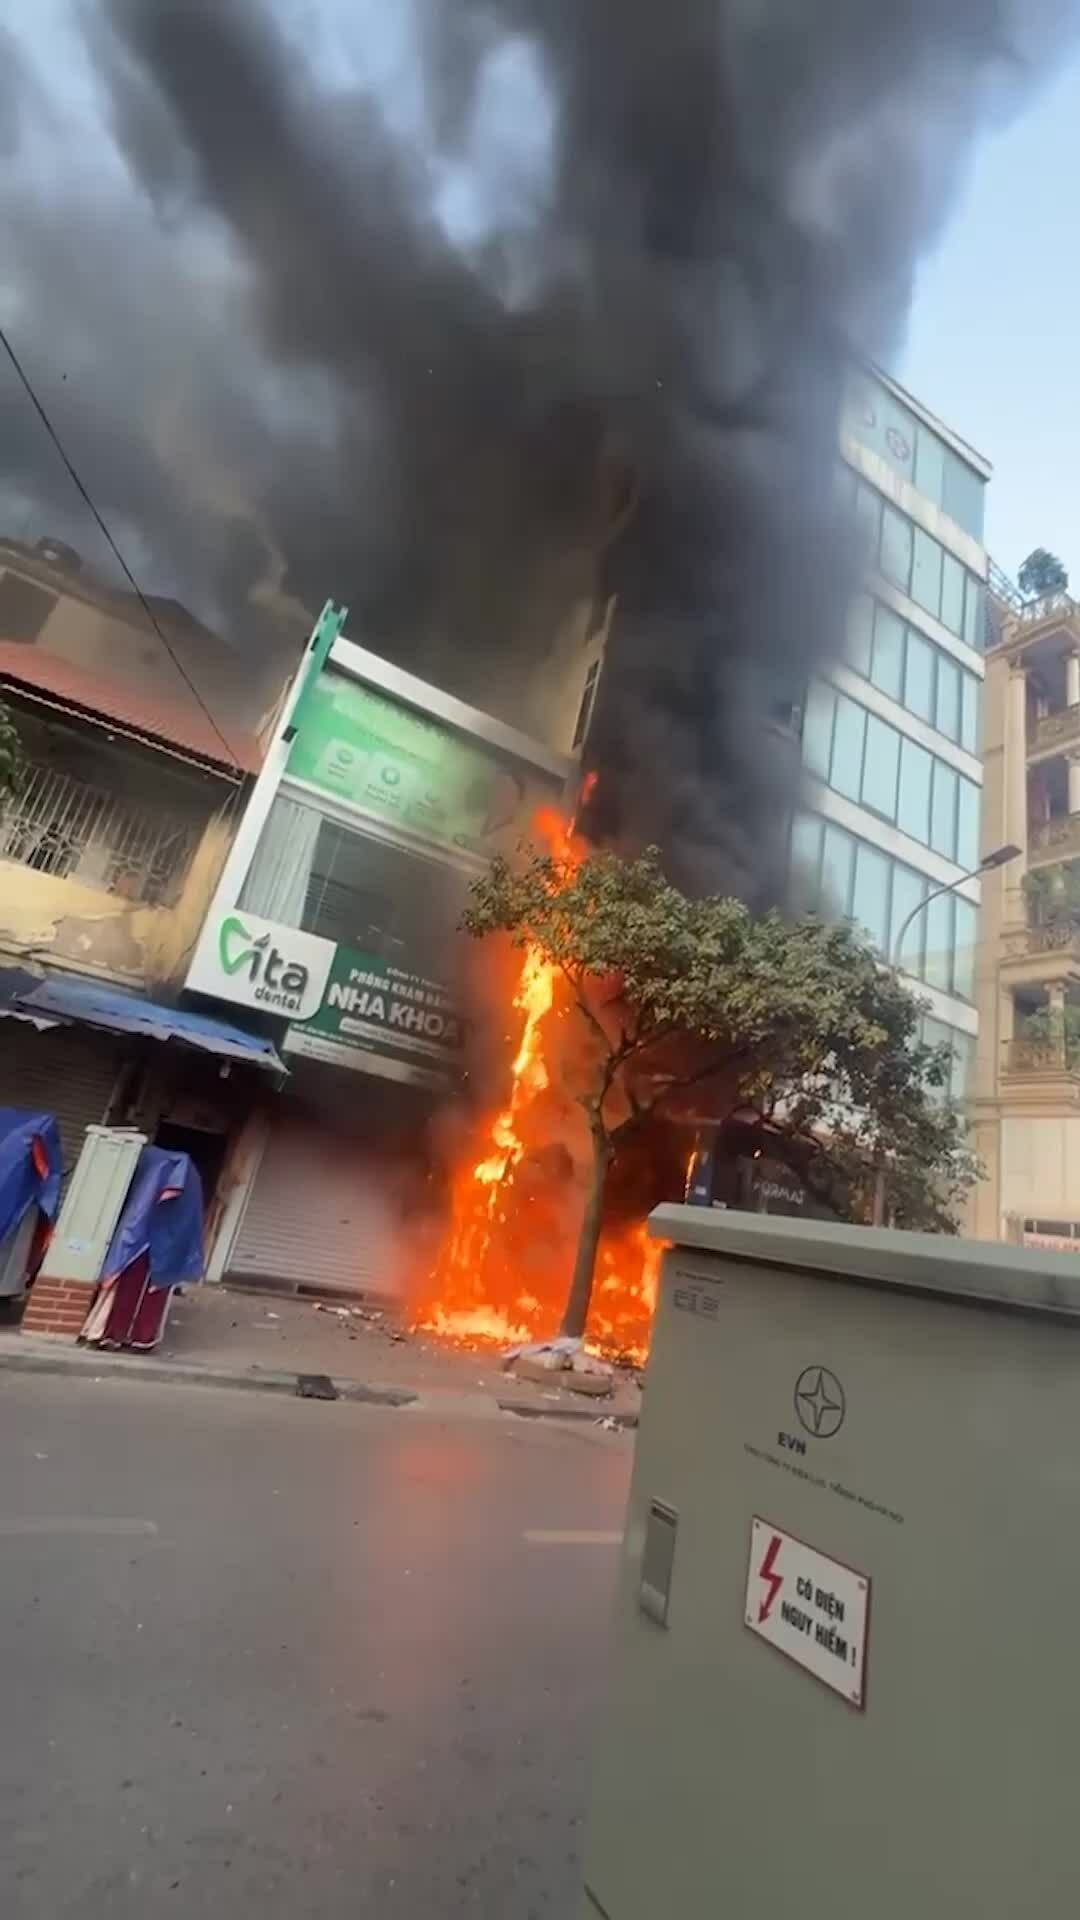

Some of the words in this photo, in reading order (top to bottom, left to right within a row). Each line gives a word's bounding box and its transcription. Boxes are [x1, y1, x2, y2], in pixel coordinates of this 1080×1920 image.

[254, 986, 301, 1011] dental
[327, 982, 385, 1020] NHA
[778, 1431, 806, 1456] EVN
[796, 1576, 812, 1601] CÓ
[815, 1587, 845, 1622] ĐIỆN
[781, 1599, 814, 1636] NGUY
[850, 1646, 857, 1668] !
